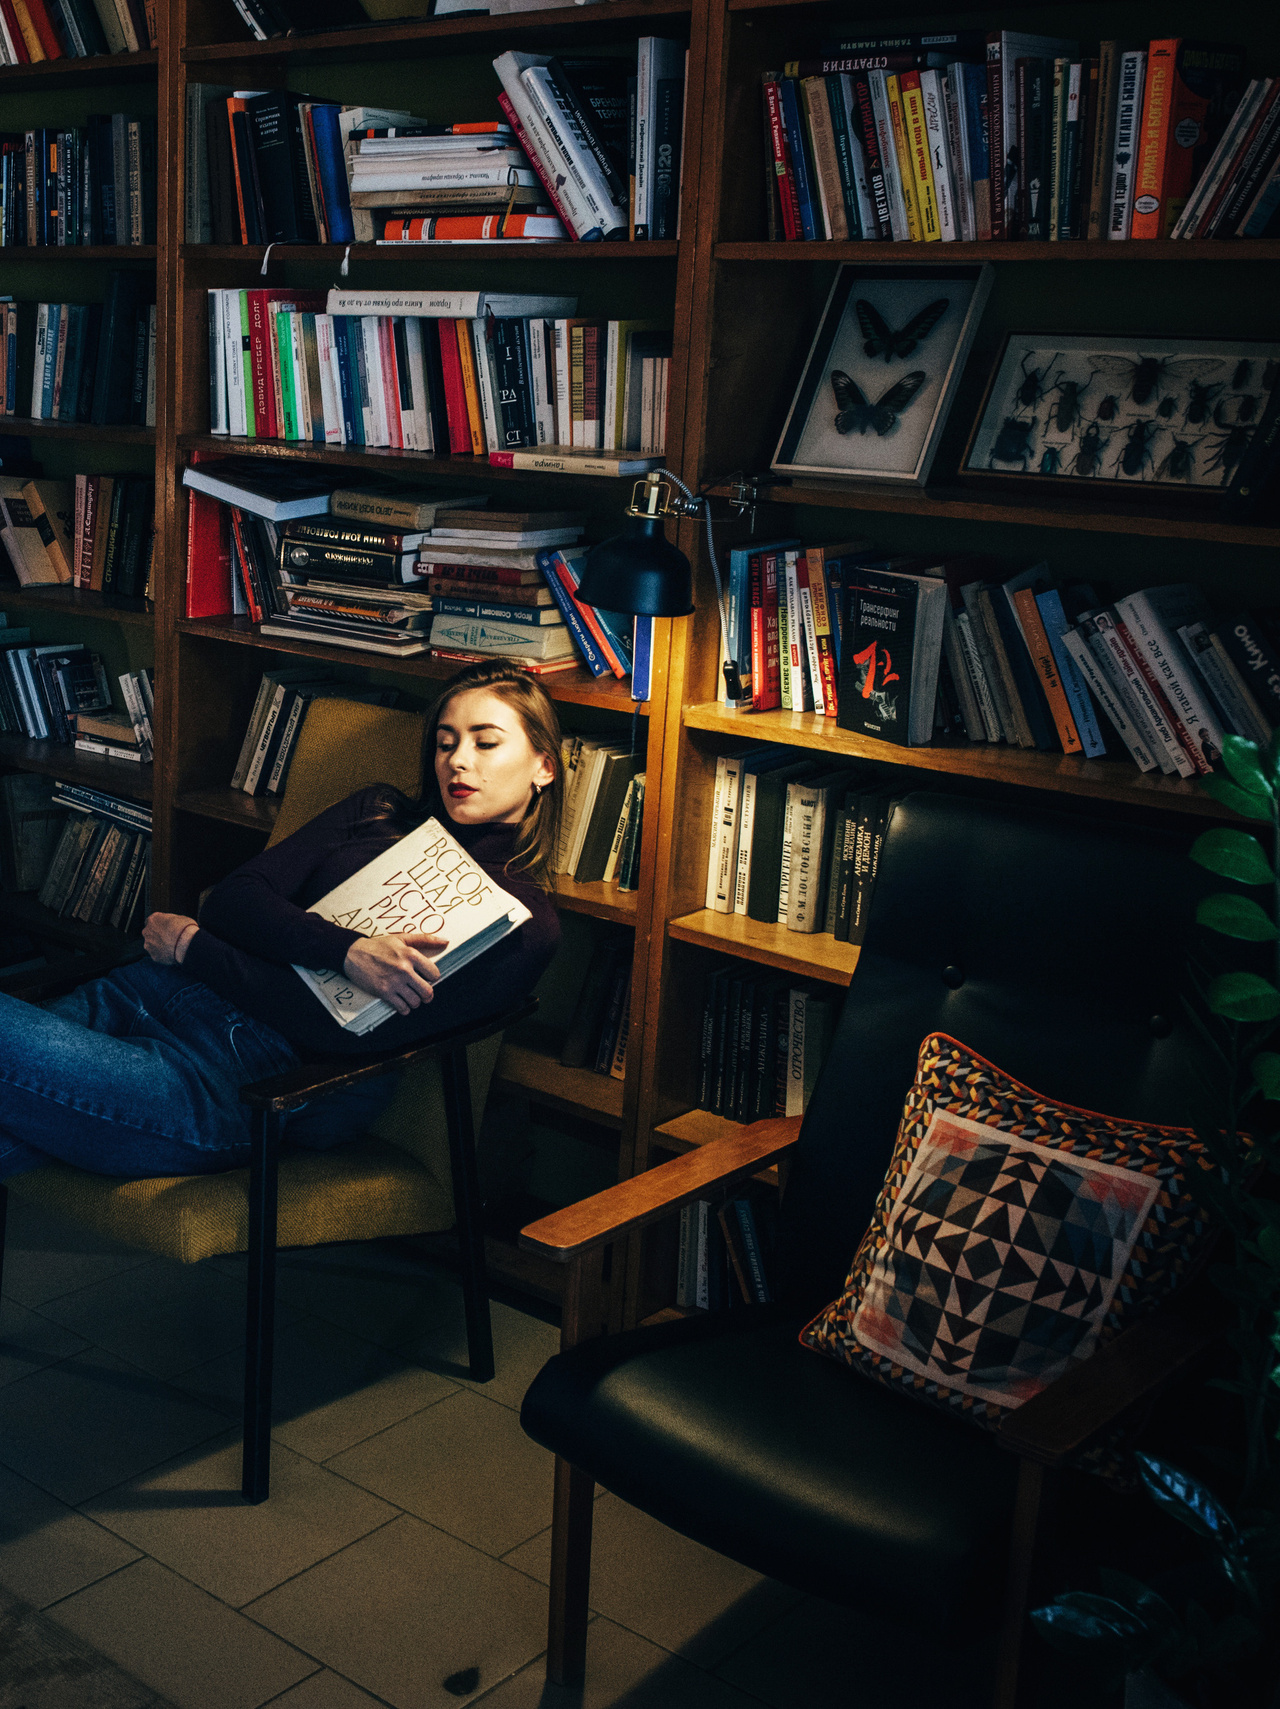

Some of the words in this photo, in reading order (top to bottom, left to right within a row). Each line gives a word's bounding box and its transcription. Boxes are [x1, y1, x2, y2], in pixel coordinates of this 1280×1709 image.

[840, 41, 876, 50] ПАМЯТИ
[880, 38, 911, 48] ТАЙНЫ
[822, 56, 888, 72] СТРАТЕГИЯ
[1122, 57, 1137, 100] БИЗНЕСА
[992, 74, 1000, 102] КНИГА
[1147, 66, 1166, 128] БОГАТЕТЬ!
[524, 113, 535, 127] всех
[856, 81, 878, 158] ИМАГИНАТОР
[909, 96, 917, 115] НЛП
[530, 125, 541, 138] для
[542, 115, 564, 146] БЕРНБАХА
[572, 109, 598, 147] ТЕРРИТОРИЙ
[913, 125, 923, 147] КОД
[992, 103, 1001, 168] РУКОВОДИТЕЛЯ
[1117, 104, 1133, 148] ГИГАНТЫ
[1147, 130, 1159, 138] И
[533, 135, 560, 173] Каллиграфия
[559, 144, 574, 165] БИЛЛА
[878, 119, 891, 169] Инфобизнес
[591, 144, 614, 176] БРЕНДИНГ
[915, 149, 928, 180] НОВЫЙ
[1141, 155, 1157, 191] ДУМАТЬ
[469, 172, 490, 180] Чихольд
[569, 164, 587, 189] БИБЛИЯ
[993, 169, 1001, 200] ОТДЕЛА
[559, 188, 580, 216] Проненко
[872, 174, 890, 222] ЦВЕТКОВ
[994, 203, 1001, 214] PR
[1228, 180, 1254, 220] ПАТЕНТНАЯ
[1111, 203, 1126, 232] РИЧАРД
[253, 300, 262, 328] ДОЛГ
[372, 298, 391, 309] буквы
[392, 299, 404, 307] про
[404, 300, 423, 309] Книга
[429, 300, 452, 309] Гордон
[255, 336, 263, 376] ГРЕБЕР
[258, 377, 266, 415] ДЭВИД
[285, 411, 293, 433] GARAGE
[345, 420, 353, 440] GARAGE
[532, 459, 565, 471] Тантра,
[335, 500, 359, 511] ЖИЗНИ
[358, 503, 374, 514] ВСЕЙ
[374, 505, 393, 515] ДЕЛО
[105, 528, 117, 583] СТРУГАЦКИЕ
[513, 610, 533, 622] Игорь
[810, 582, 821, 628] СОЦИАЛЬНЫЙ
[817, 581, 827, 628] КОНФЛИКТ
[860, 598, 900, 619] Трансерфинг
[566, 611, 583, 634] любви
[781, 608, 790, 654] Настроение
[802, 591, 815, 651] Истинноверующий
[860, 614, 897, 632] реальности
[575, 632, 598, 662] Секреты
[782, 656, 789, 665] по
[1093, 638, 1105, 653] ПОЛ
[1101, 652, 1118, 675] ЭКМАН
[1107, 635, 1136, 677] Тайм-драйв
[1145, 637, 1163, 659] все
[1229, 620, 1270, 672] Кино
[1077, 652, 1097, 680] Уорхола
[1156, 657, 1175, 681] как
[782, 668, 791, 695] заказу
[1092, 678, 1107, 696] Энди
[1120, 686, 1149, 729] ПСИХОЛОГИЯ
[1130, 676, 1165, 727] Архангельский
[1167, 679, 1194, 715] такой
[1101, 693, 1128, 731] Философия
[1185, 713, 1199, 727] Я
[1158, 725, 1173, 743] Глеб
[742, 784, 753, 816] ТУРГЕНЕВ
[709, 820, 719, 848] МАКСИМ
[839, 818, 853, 861] ИСКУШЕНИЕ
[845, 820, 858, 861] АНЖЕЛИКИ
[860, 831, 874, 864] ДЕМОН
[792, 814, 817, 897] ДОСТОЕВСКИЙ
[850, 824, 868, 876] АНЖЕЛИКА
[868, 833, 882, 878] АНЖЕЛИКА
[424, 837, 493, 906] ВСЕОБ
[861, 864, 869, 872] И
[369, 895, 418, 936] РИЯ
[382, 871, 445, 935] ИСТО
[795, 911, 805, 922] Ф.
[797, 897, 807, 909] М.
[756, 1012, 768, 1074] АНЖЕЛИКА
[791, 1000, 804, 1080] ОТРОЧЕСТВО
